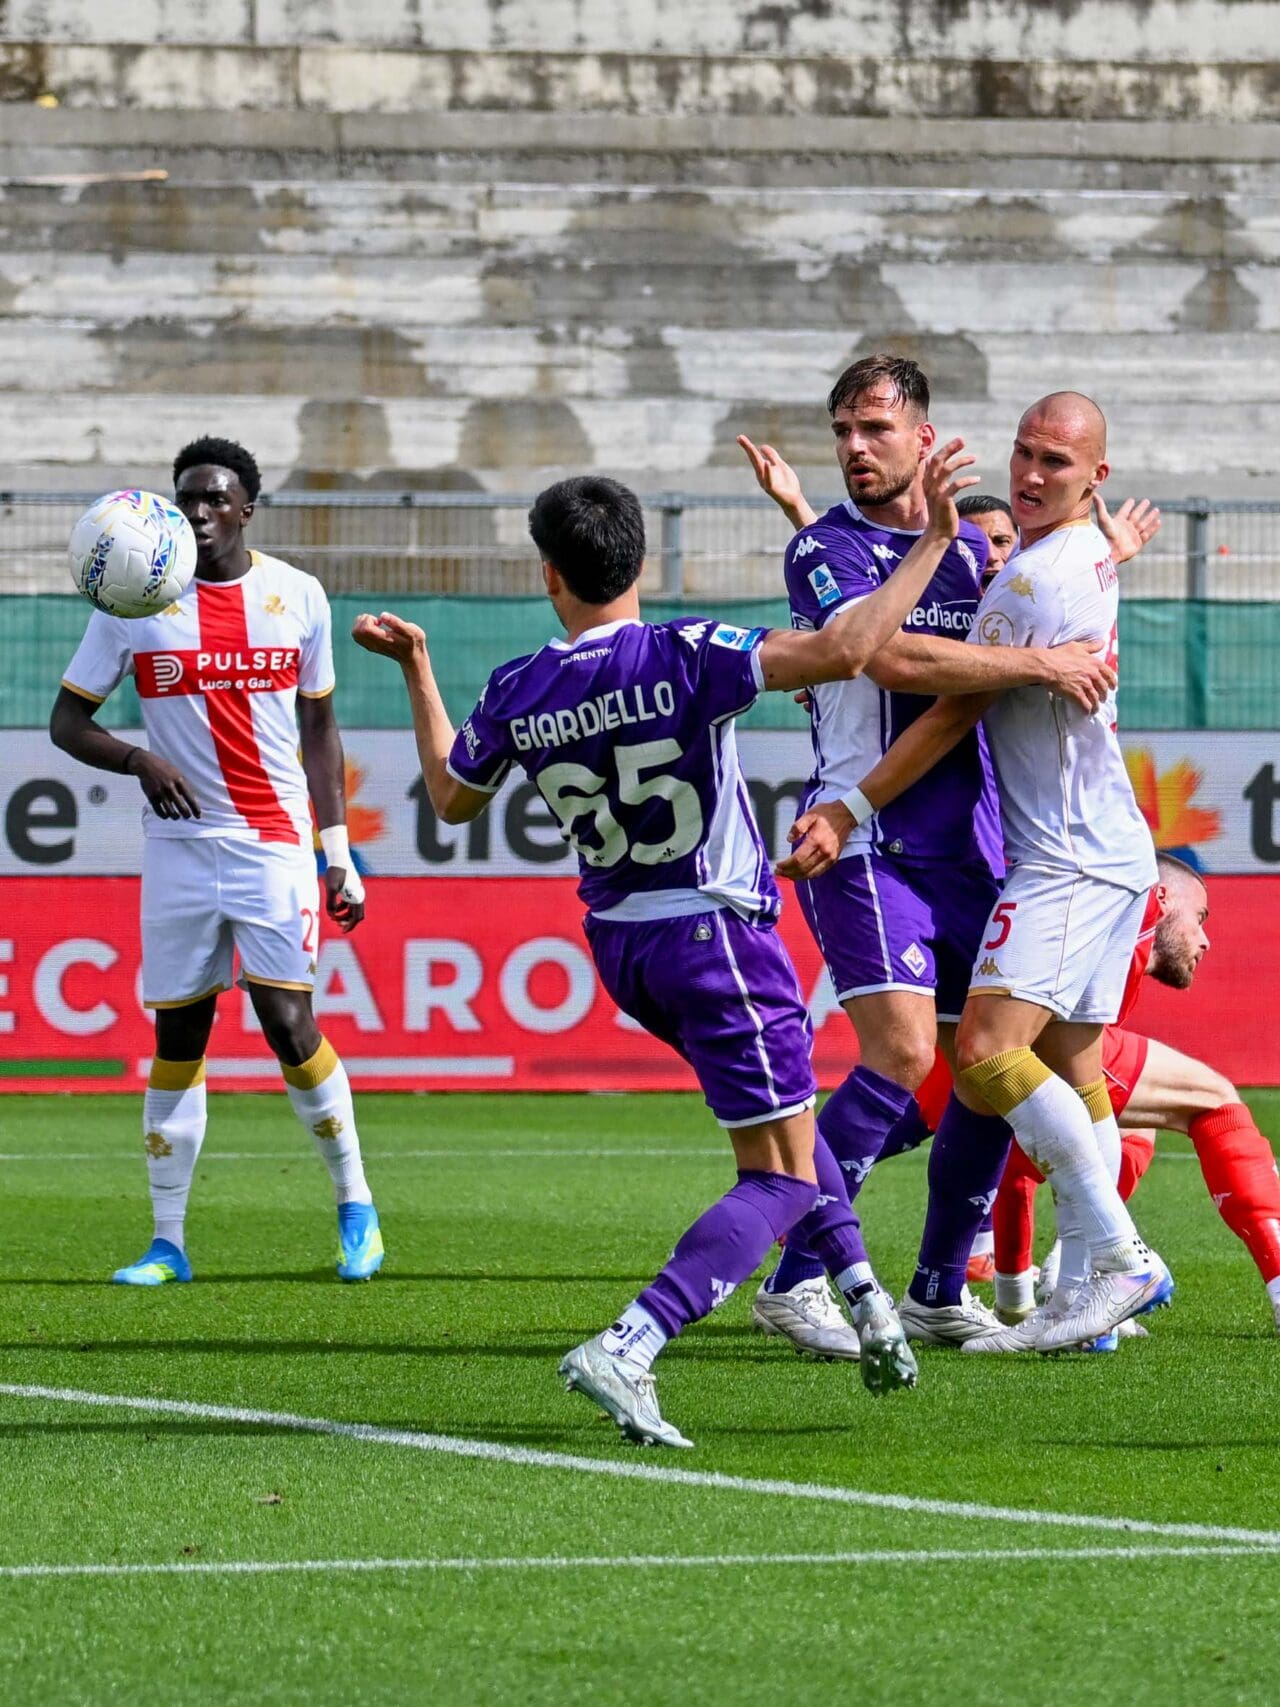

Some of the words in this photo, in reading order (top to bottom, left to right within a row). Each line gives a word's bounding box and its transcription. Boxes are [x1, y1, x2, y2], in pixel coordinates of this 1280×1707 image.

[905, 599, 977, 630] ediaco
[198, 678, 231, 690] Luce
[235, 679, 244, 690] e
[247, 677, 272, 689] Gas
[536, 737, 704, 868] 65
[984, 902, 1017, 950] 5
